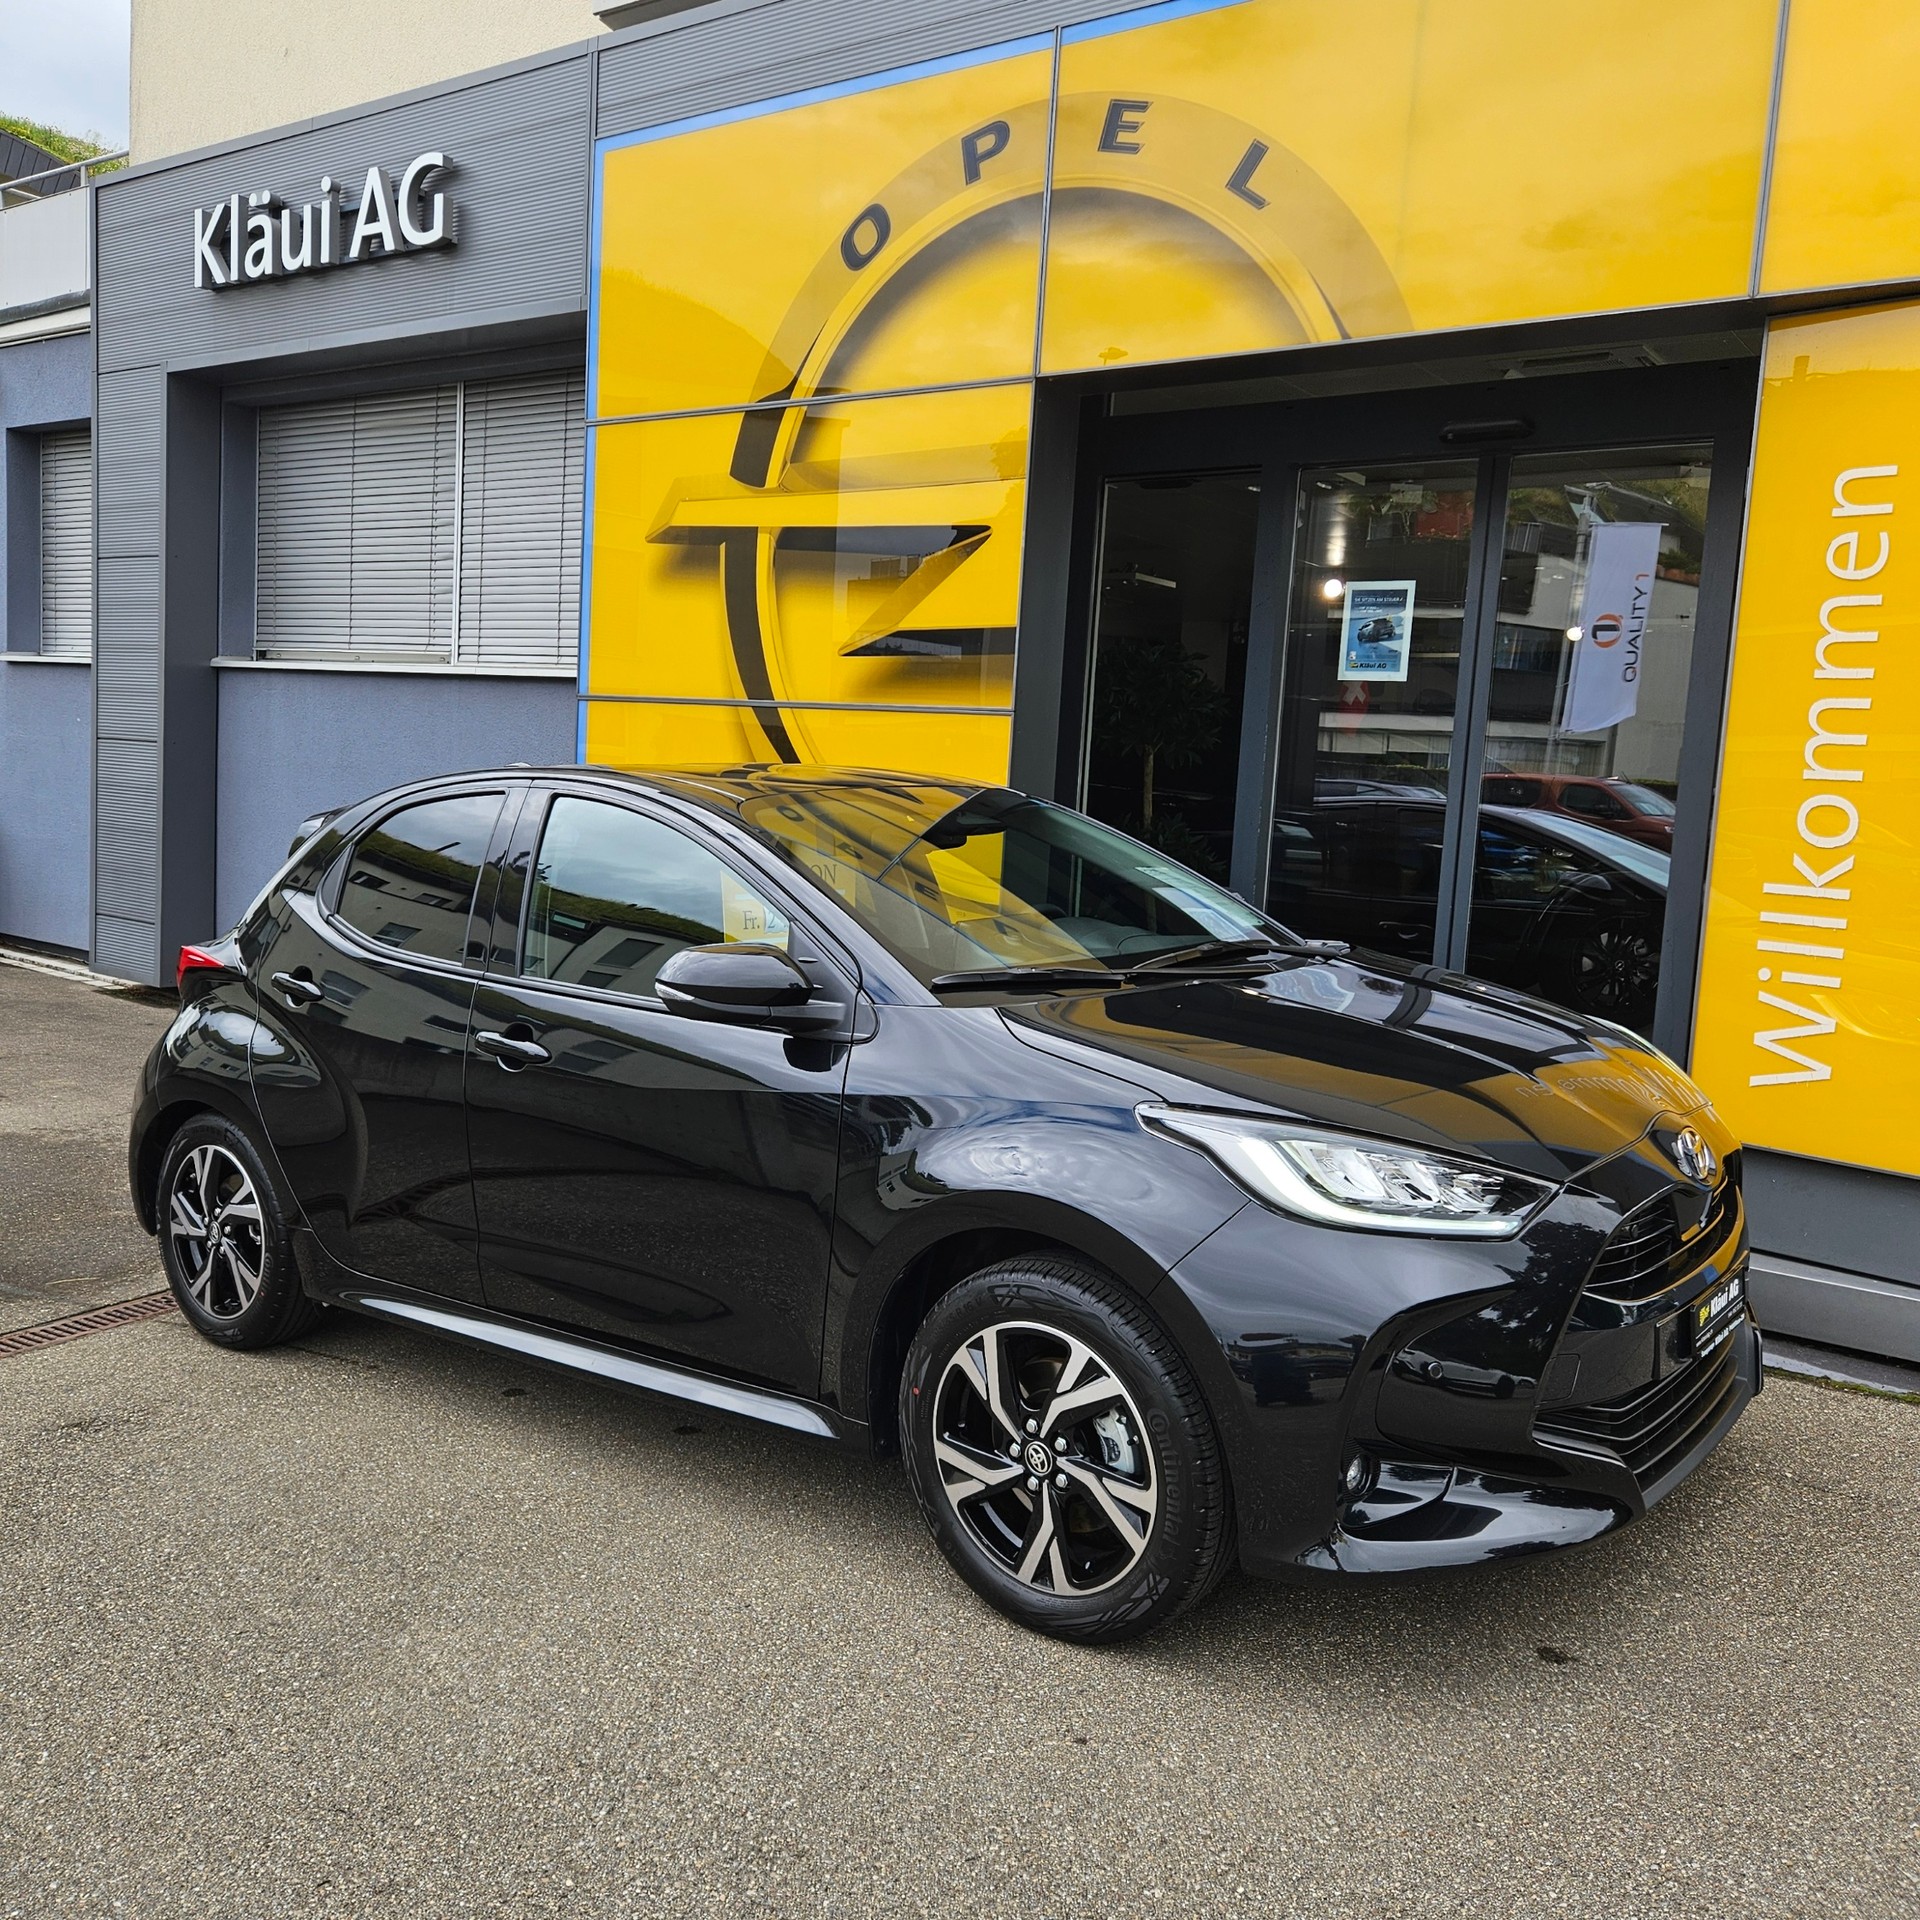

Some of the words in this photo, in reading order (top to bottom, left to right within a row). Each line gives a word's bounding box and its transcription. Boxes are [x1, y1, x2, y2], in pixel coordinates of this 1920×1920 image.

[194, 175, 336, 289] Kläui
[349, 152, 451, 259] AG
[840, 98, 1271, 271] OPEL
[1622, 585, 1649, 682] QUALITY
[1749, 464, 1899, 1088] Willkommen
[742, 910, 760, 930] Fr.
[1710, 1286, 1728, 1317] Kläui
[1728, 1278, 1740, 1302] AG
[1147, 1408, 1182, 1546] Continental
